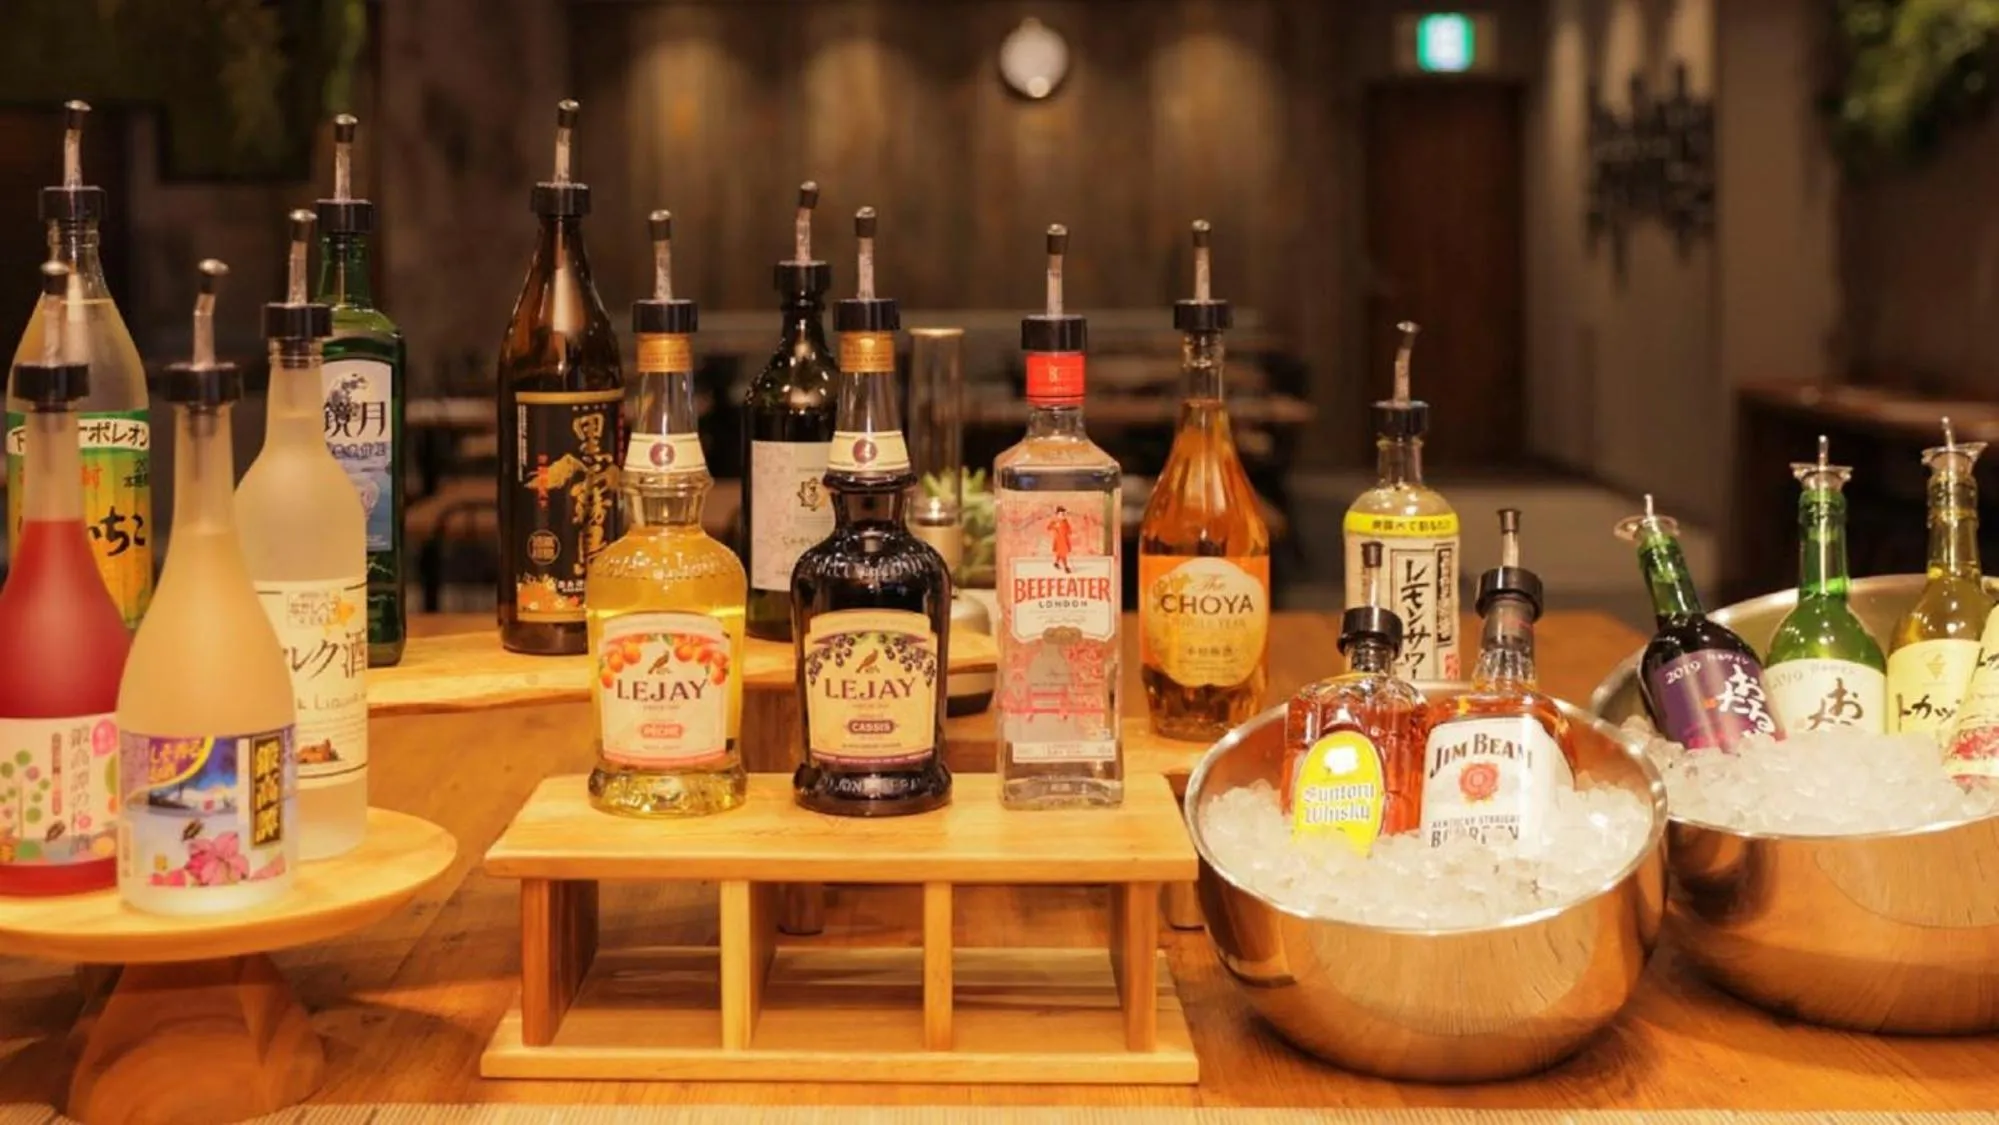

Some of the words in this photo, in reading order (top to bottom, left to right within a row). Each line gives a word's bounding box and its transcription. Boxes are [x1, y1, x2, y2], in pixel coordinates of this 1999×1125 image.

[1014, 575, 1111, 603] BEEFEATER
[1038, 600, 1088, 609] LONDON
[1160, 594, 1255, 615] CHOYA
[1400, 559, 1432, 680] レモンサワー
[616, 679, 708, 701] LEJAY
[824, 678, 916, 700] LEJAY
[851, 721, 891, 732] CASSIS
[1429, 741, 1468, 779] JIM
[1303, 783, 1375, 803] Suntory
[1304, 803, 1371, 823] Whisky
